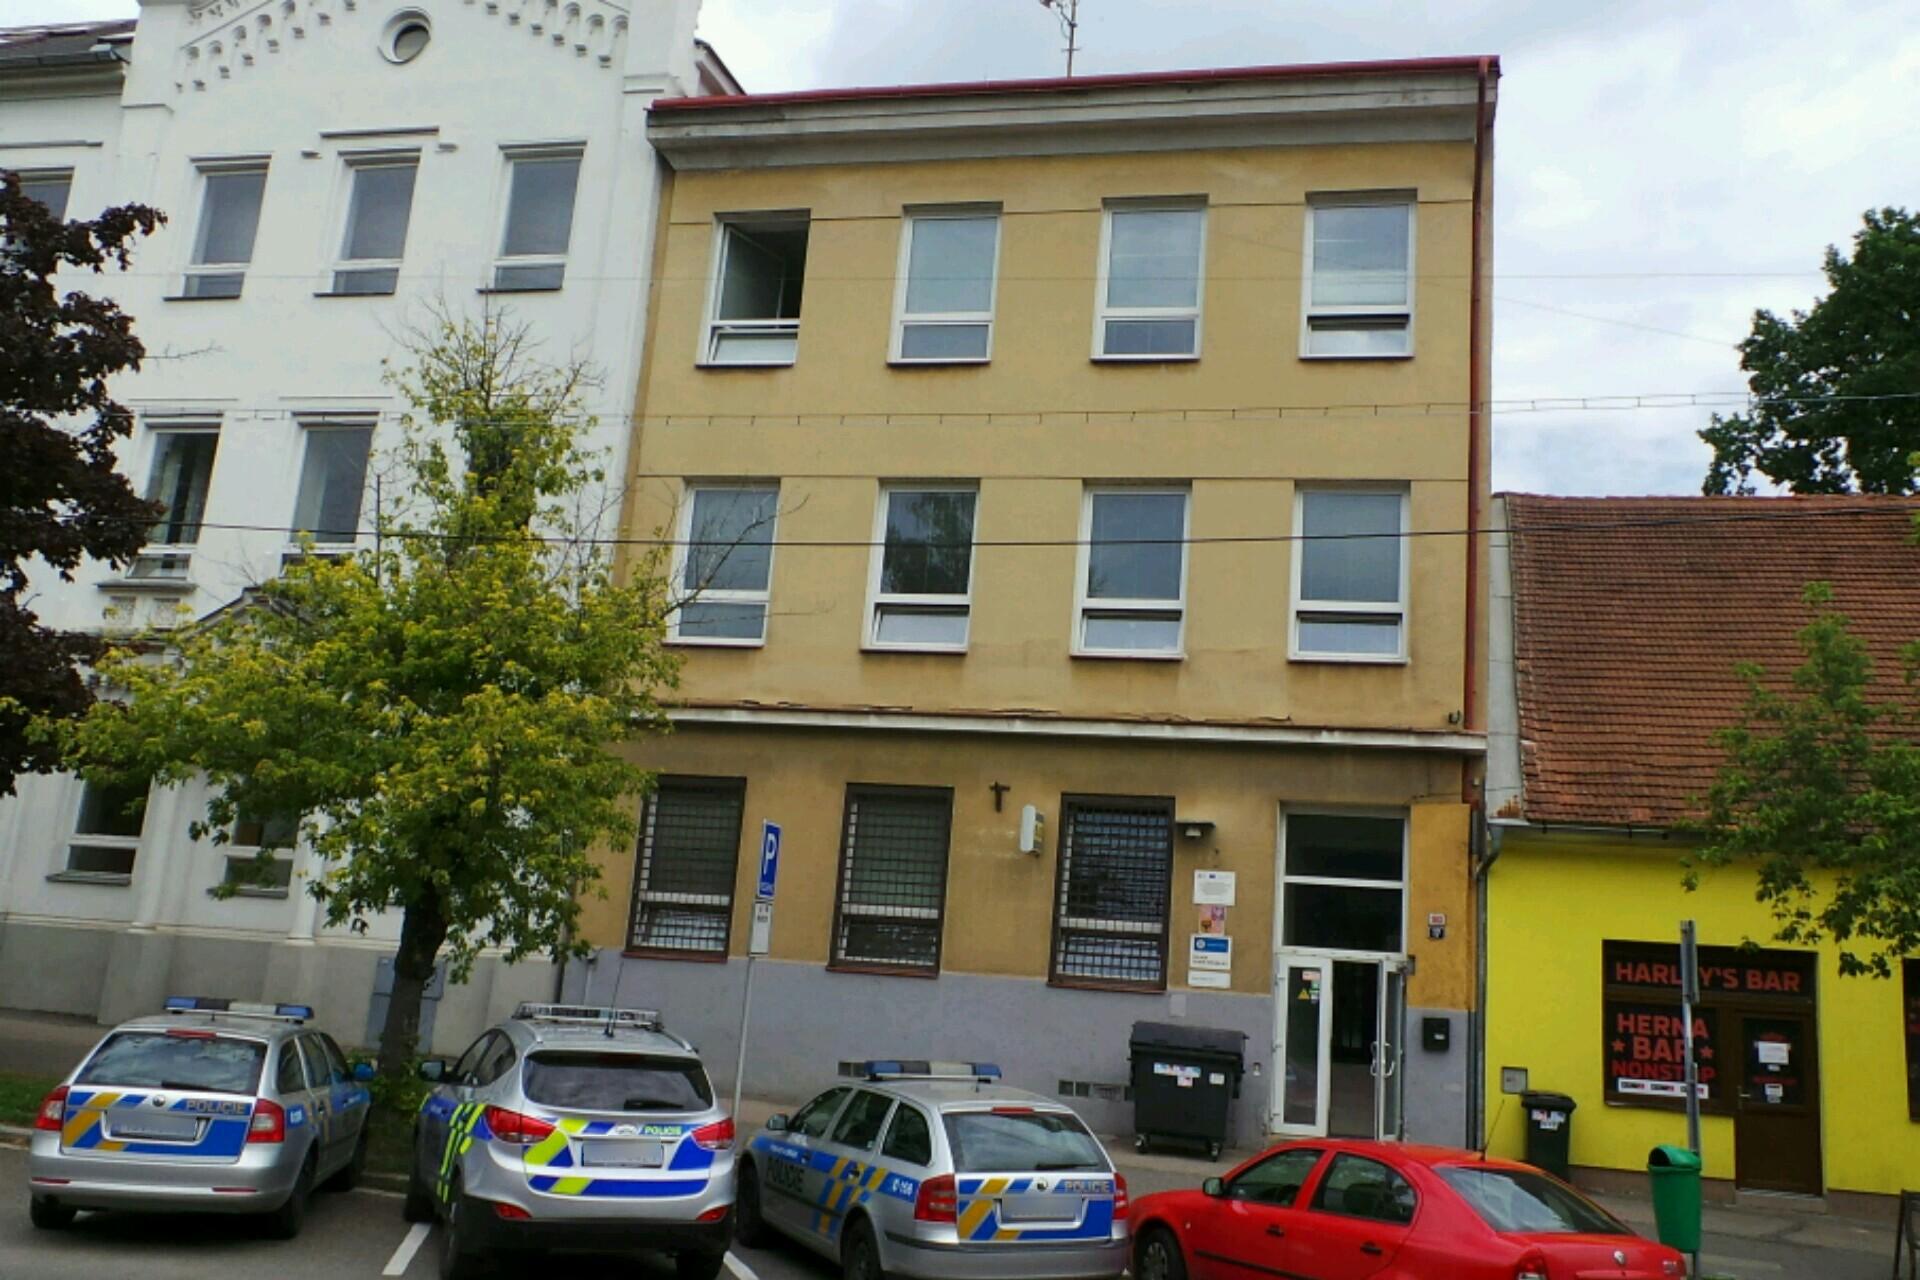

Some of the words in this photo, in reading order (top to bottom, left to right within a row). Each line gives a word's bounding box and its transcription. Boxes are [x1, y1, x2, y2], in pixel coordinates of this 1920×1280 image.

[764, 833, 777, 875] P
[1615, 962, 1738, 988] HARLY'S
[1746, 969, 1800, 992] BAR
[1611, 1060, 1716, 1082] NONSTP
[186, 1099, 246, 1115] POLICIE
[644, 1125, 682, 1136] POLICIE
[1064, 1180, 1111, 1193] POLICIE
